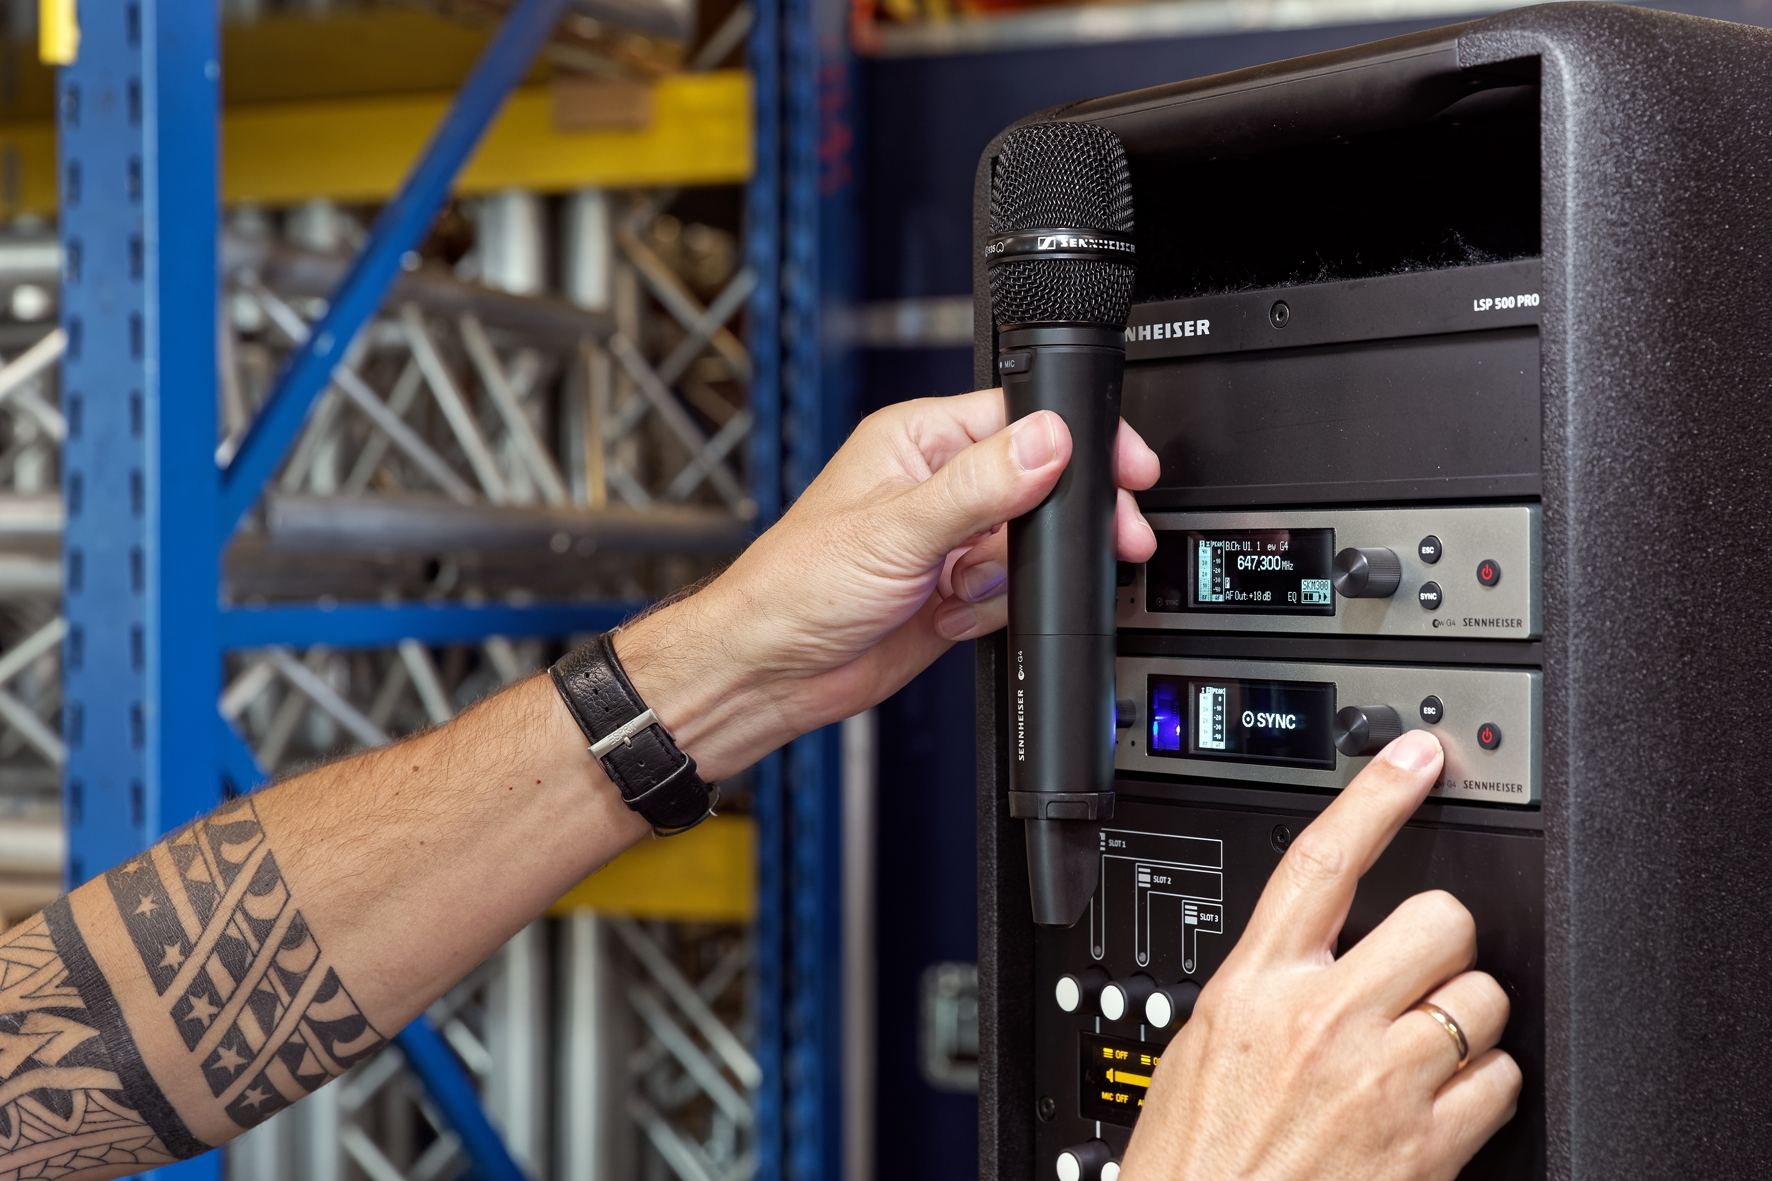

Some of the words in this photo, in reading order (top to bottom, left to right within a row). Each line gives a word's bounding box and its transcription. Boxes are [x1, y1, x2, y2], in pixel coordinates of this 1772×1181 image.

[1060, 238, 1136, 253] SENNHEISER
[1473, 298, 1493, 311] LSP
[1494, 296, 1515, 309] 500
[1517, 293, 1540, 307] PRO
[1124, 319, 1210, 342] NHEISER
[1004, 360, 1015, 368] MIC
[1267, 543, 1277, 551] ew
[1280, 541, 1289, 551] G4
[1421, 546, 1435, 554] ESC
[1237, 555, 1281, 571] 647.300
[1282, 560, 1294, 571] MHz
[1225, 591, 1234, 601] AF
[1288, 591, 1297, 603] EQ
[1420, 592, 1437, 600] SYNC
[1463, 617, 1523, 628] SENNHEISER
[1423, 706, 1436, 715] ESC
[1017, 689, 1025, 761] SENNHEISER
[1257, 712, 1296, 729] SYNC
[1463, 780, 1523, 793] SENNHEISER
[1108, 839, 1121, 847] SLOT
[1153, 875, 1167, 884] SLOT
[1200, 912, 1214, 922] SLOT
[1214, 914, 1219, 922] 3
[1115, 1050, 1128, 1060] OFF
[1101, 1091, 1114, 1101] MIC
[1115, 1093, 1129, 1103] OFF
